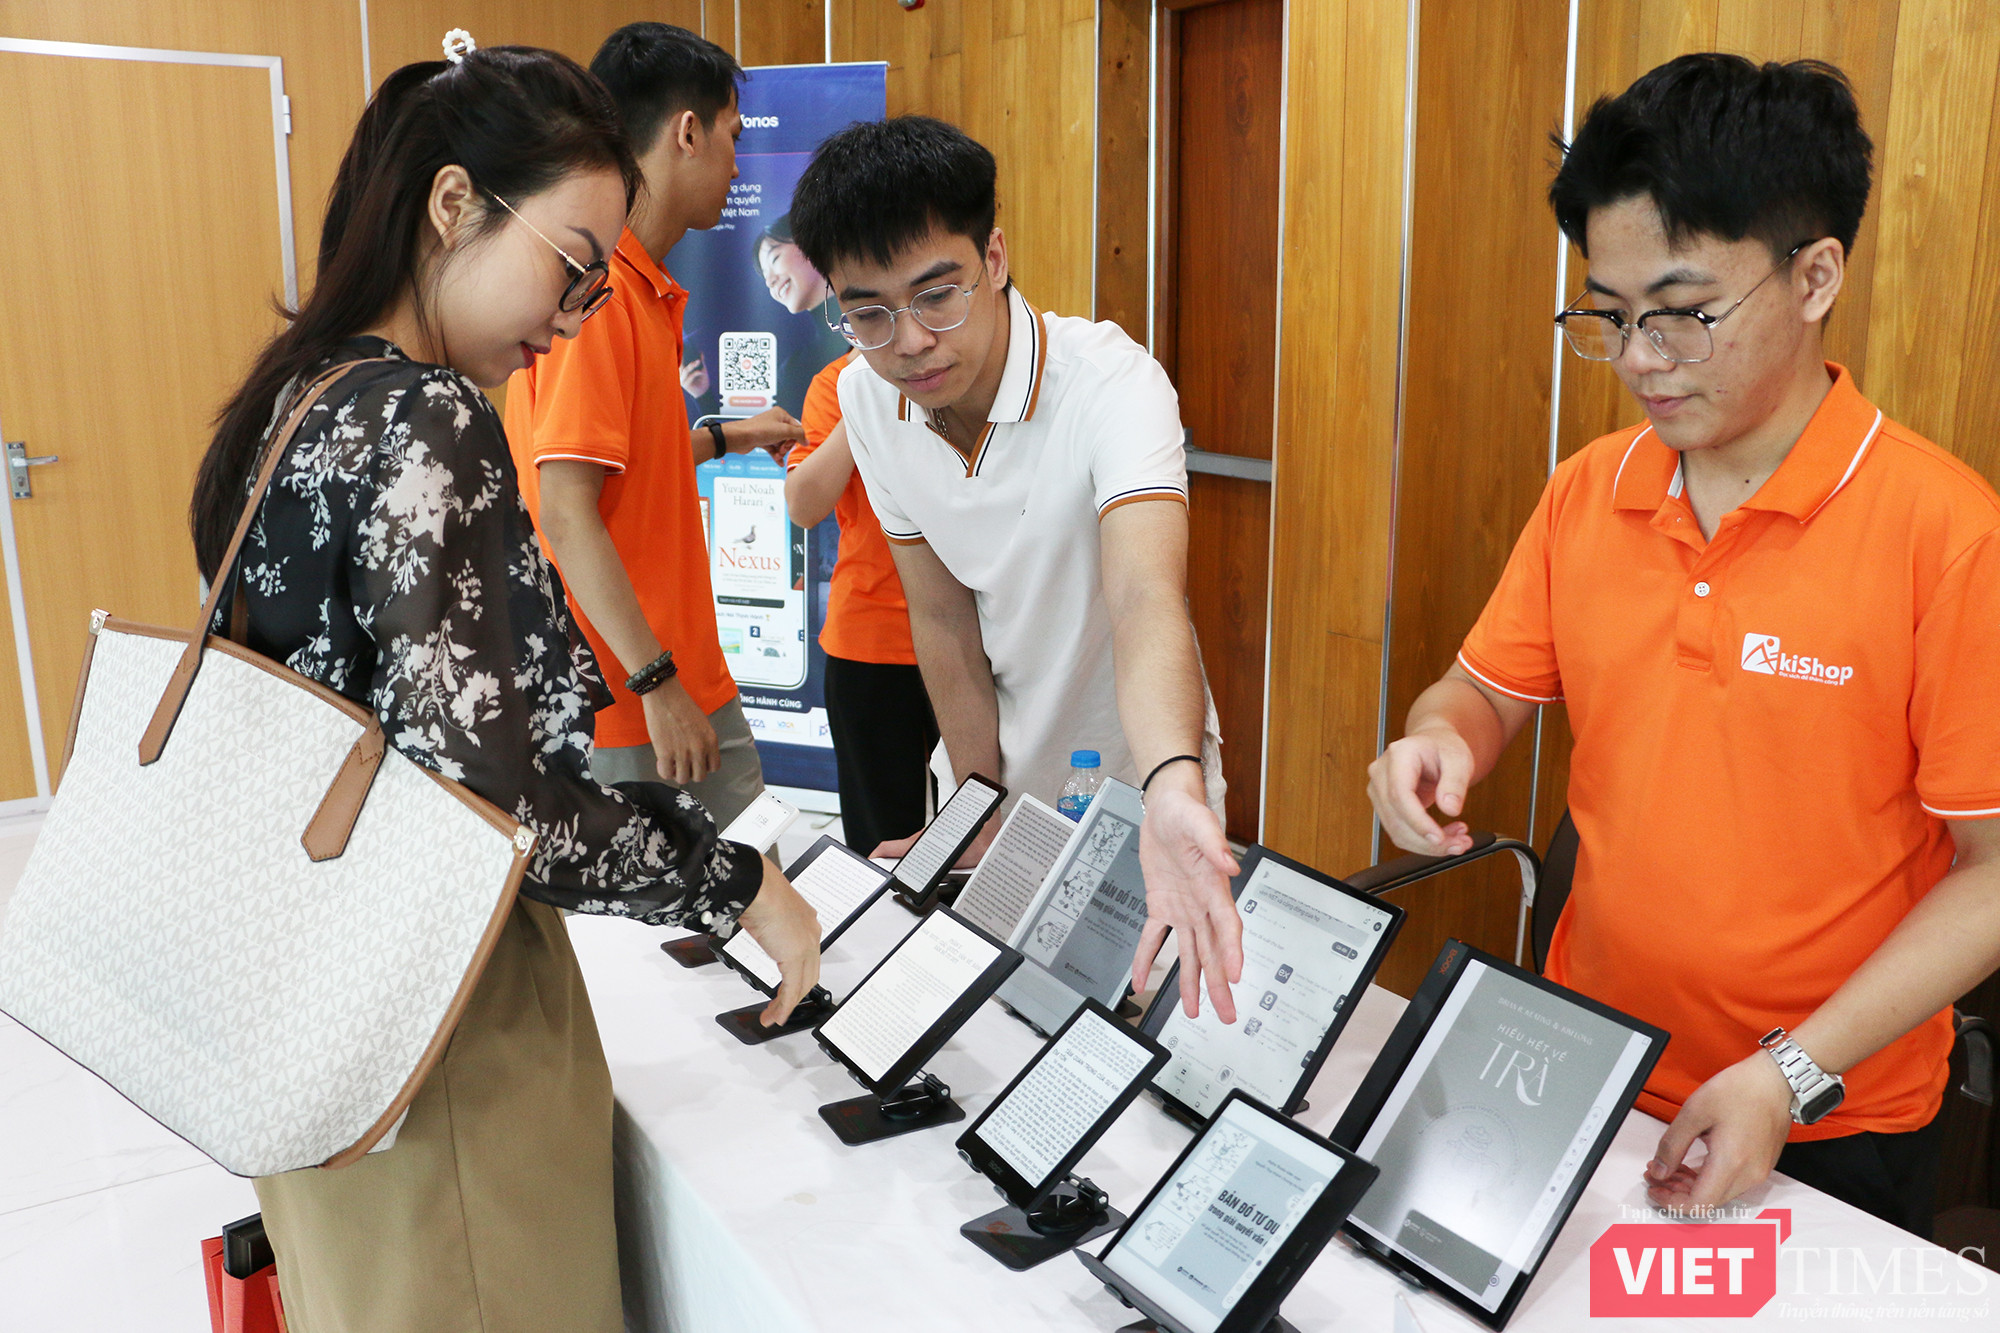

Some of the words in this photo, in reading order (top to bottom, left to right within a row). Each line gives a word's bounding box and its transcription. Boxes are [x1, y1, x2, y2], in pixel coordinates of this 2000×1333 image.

[740, 114, 779, 128] fonos
[739, 184, 761, 193] dụng
[721, 208, 737, 218] Việt
[738, 208, 760, 217] Nam
[722, 483, 745, 493] Yuval
[749, 484, 775, 495] Noah
[733, 495, 763, 506] Harari
[719, 546, 781, 571] Nexus
[752, 627, 758, 636] 2
[740, 692, 755, 704] NG
[756, 694, 778, 706] HÀNH
[1098, 880, 1118, 899] BẢN
[1438, 949, 1459, 975] BOOX
[1527, 1037, 1550, 1053] HẾT
[1551, 1049, 1568, 1063] VỀ
[1479, 1037, 1550, 1107] TRÀ
[1217, 1189, 1240, 1209] BẢN
[1237, 1202, 1256, 1217] ĐỒ
[1251, 1210, 1269, 1225] TƯ
[1208, 1204, 1224, 1219] trong
[1222, 1215, 1236, 1226] giải
[1235, 1223, 1254, 1237] quyết
[1252, 1233, 1264, 1245] vấn
